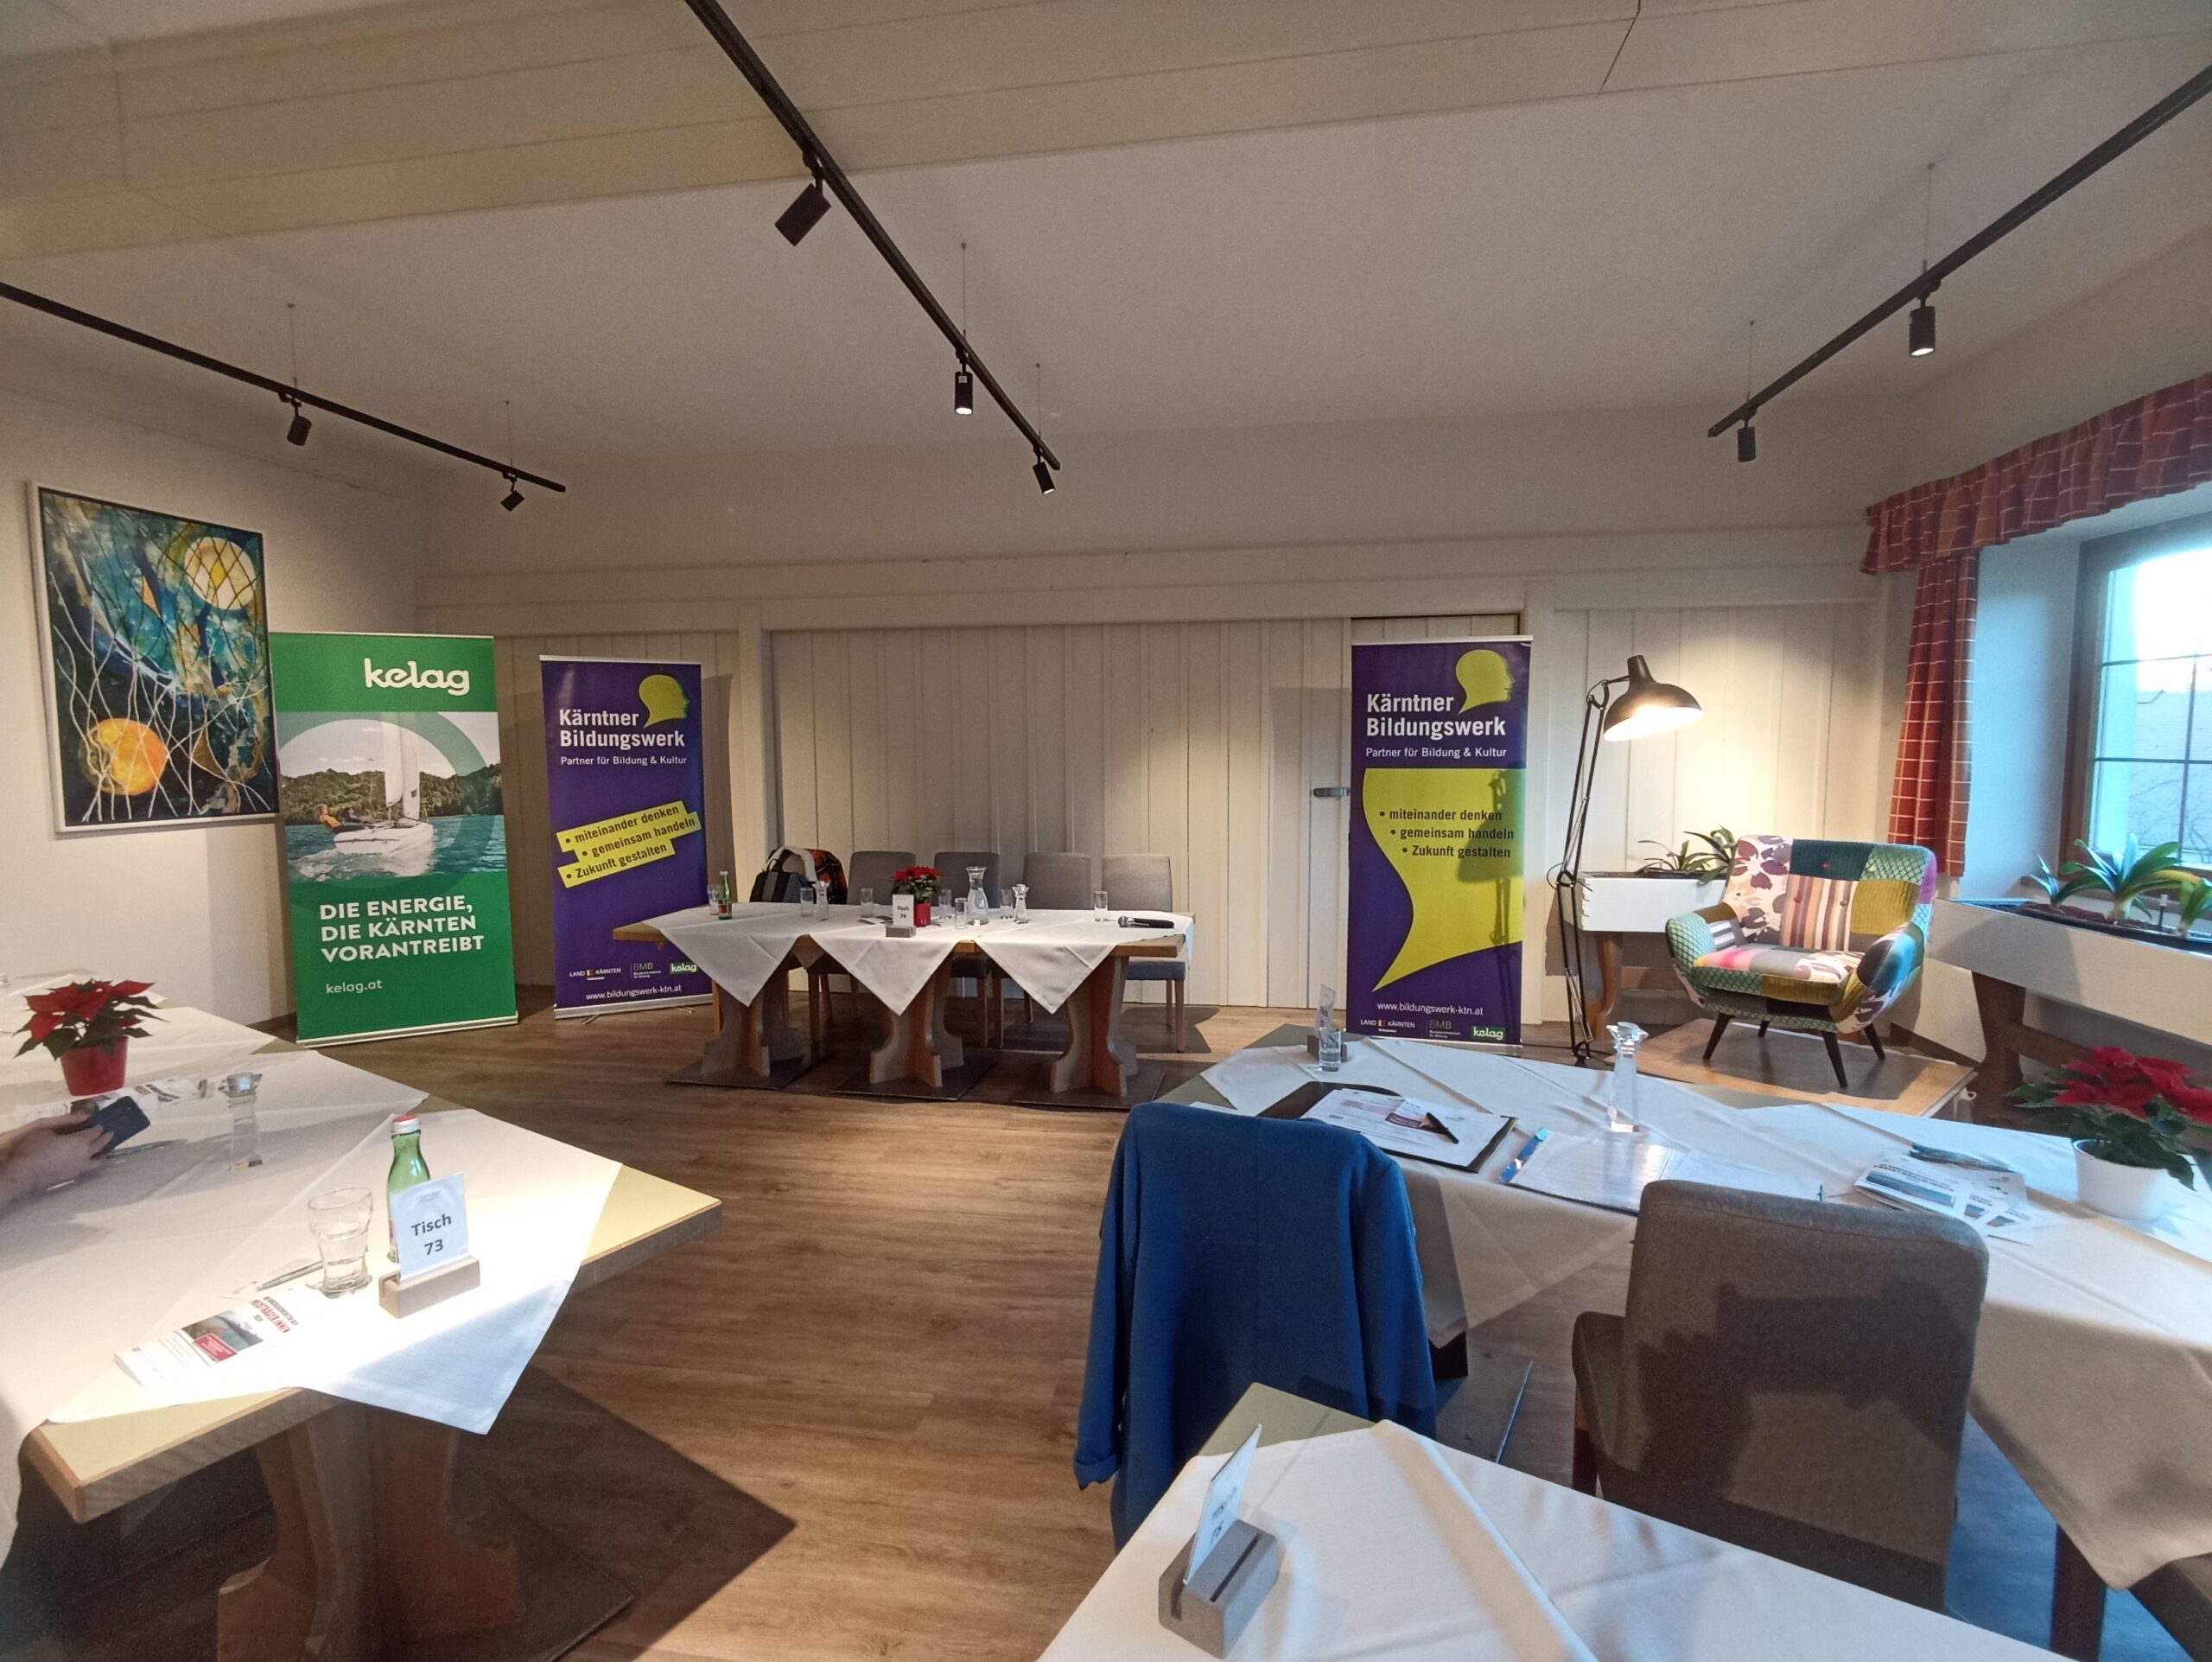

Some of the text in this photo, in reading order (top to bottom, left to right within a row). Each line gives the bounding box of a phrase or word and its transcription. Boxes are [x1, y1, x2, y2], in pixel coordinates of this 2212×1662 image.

[364, 658, 470, 696] kelag
[1367, 693, 1454, 712] Kärntner
[559, 709, 639, 726] Kärntner
[1366, 716, 1506, 740] Bildungswerk
[560, 729, 685, 750] Bildungswerk
[561, 755, 687, 766] Partner für Bildung & Kultur
[1366, 747, 1507, 759] Partner für Bildung & Kultur
[1389, 808, 1502, 821] miteinander denken
[575, 806, 679, 844] miteinander denken
[1400, 827, 1514, 840] gemeinsam handeln
[591, 818, 696, 857] gemeinsam handeln
[1412, 844, 1510, 859] Zukunft gestalten
[575, 844, 667, 879] Zukunft gestalten
[320, 895, 474, 920] DIE ENERGIE,
[321, 915, 476, 941] DIE KÄRNTEN
[321, 935, 485, 963] VORANTREIBT
[632, 963, 653, 971] BMB
[326, 979, 383, 994] kelag.at
[586, 984, 682, 1001] www.bildungswerk-ktn.at
[1376, 1003, 1484, 1016] www.bildungswerk-ktn.at
[1429, 1020, 1452, 1029] BMB
[1473, 1026, 1503, 1041] kelag
[411, 1213, 451, 1236] Tisch
[424, 1239, 443, 1256] 73
